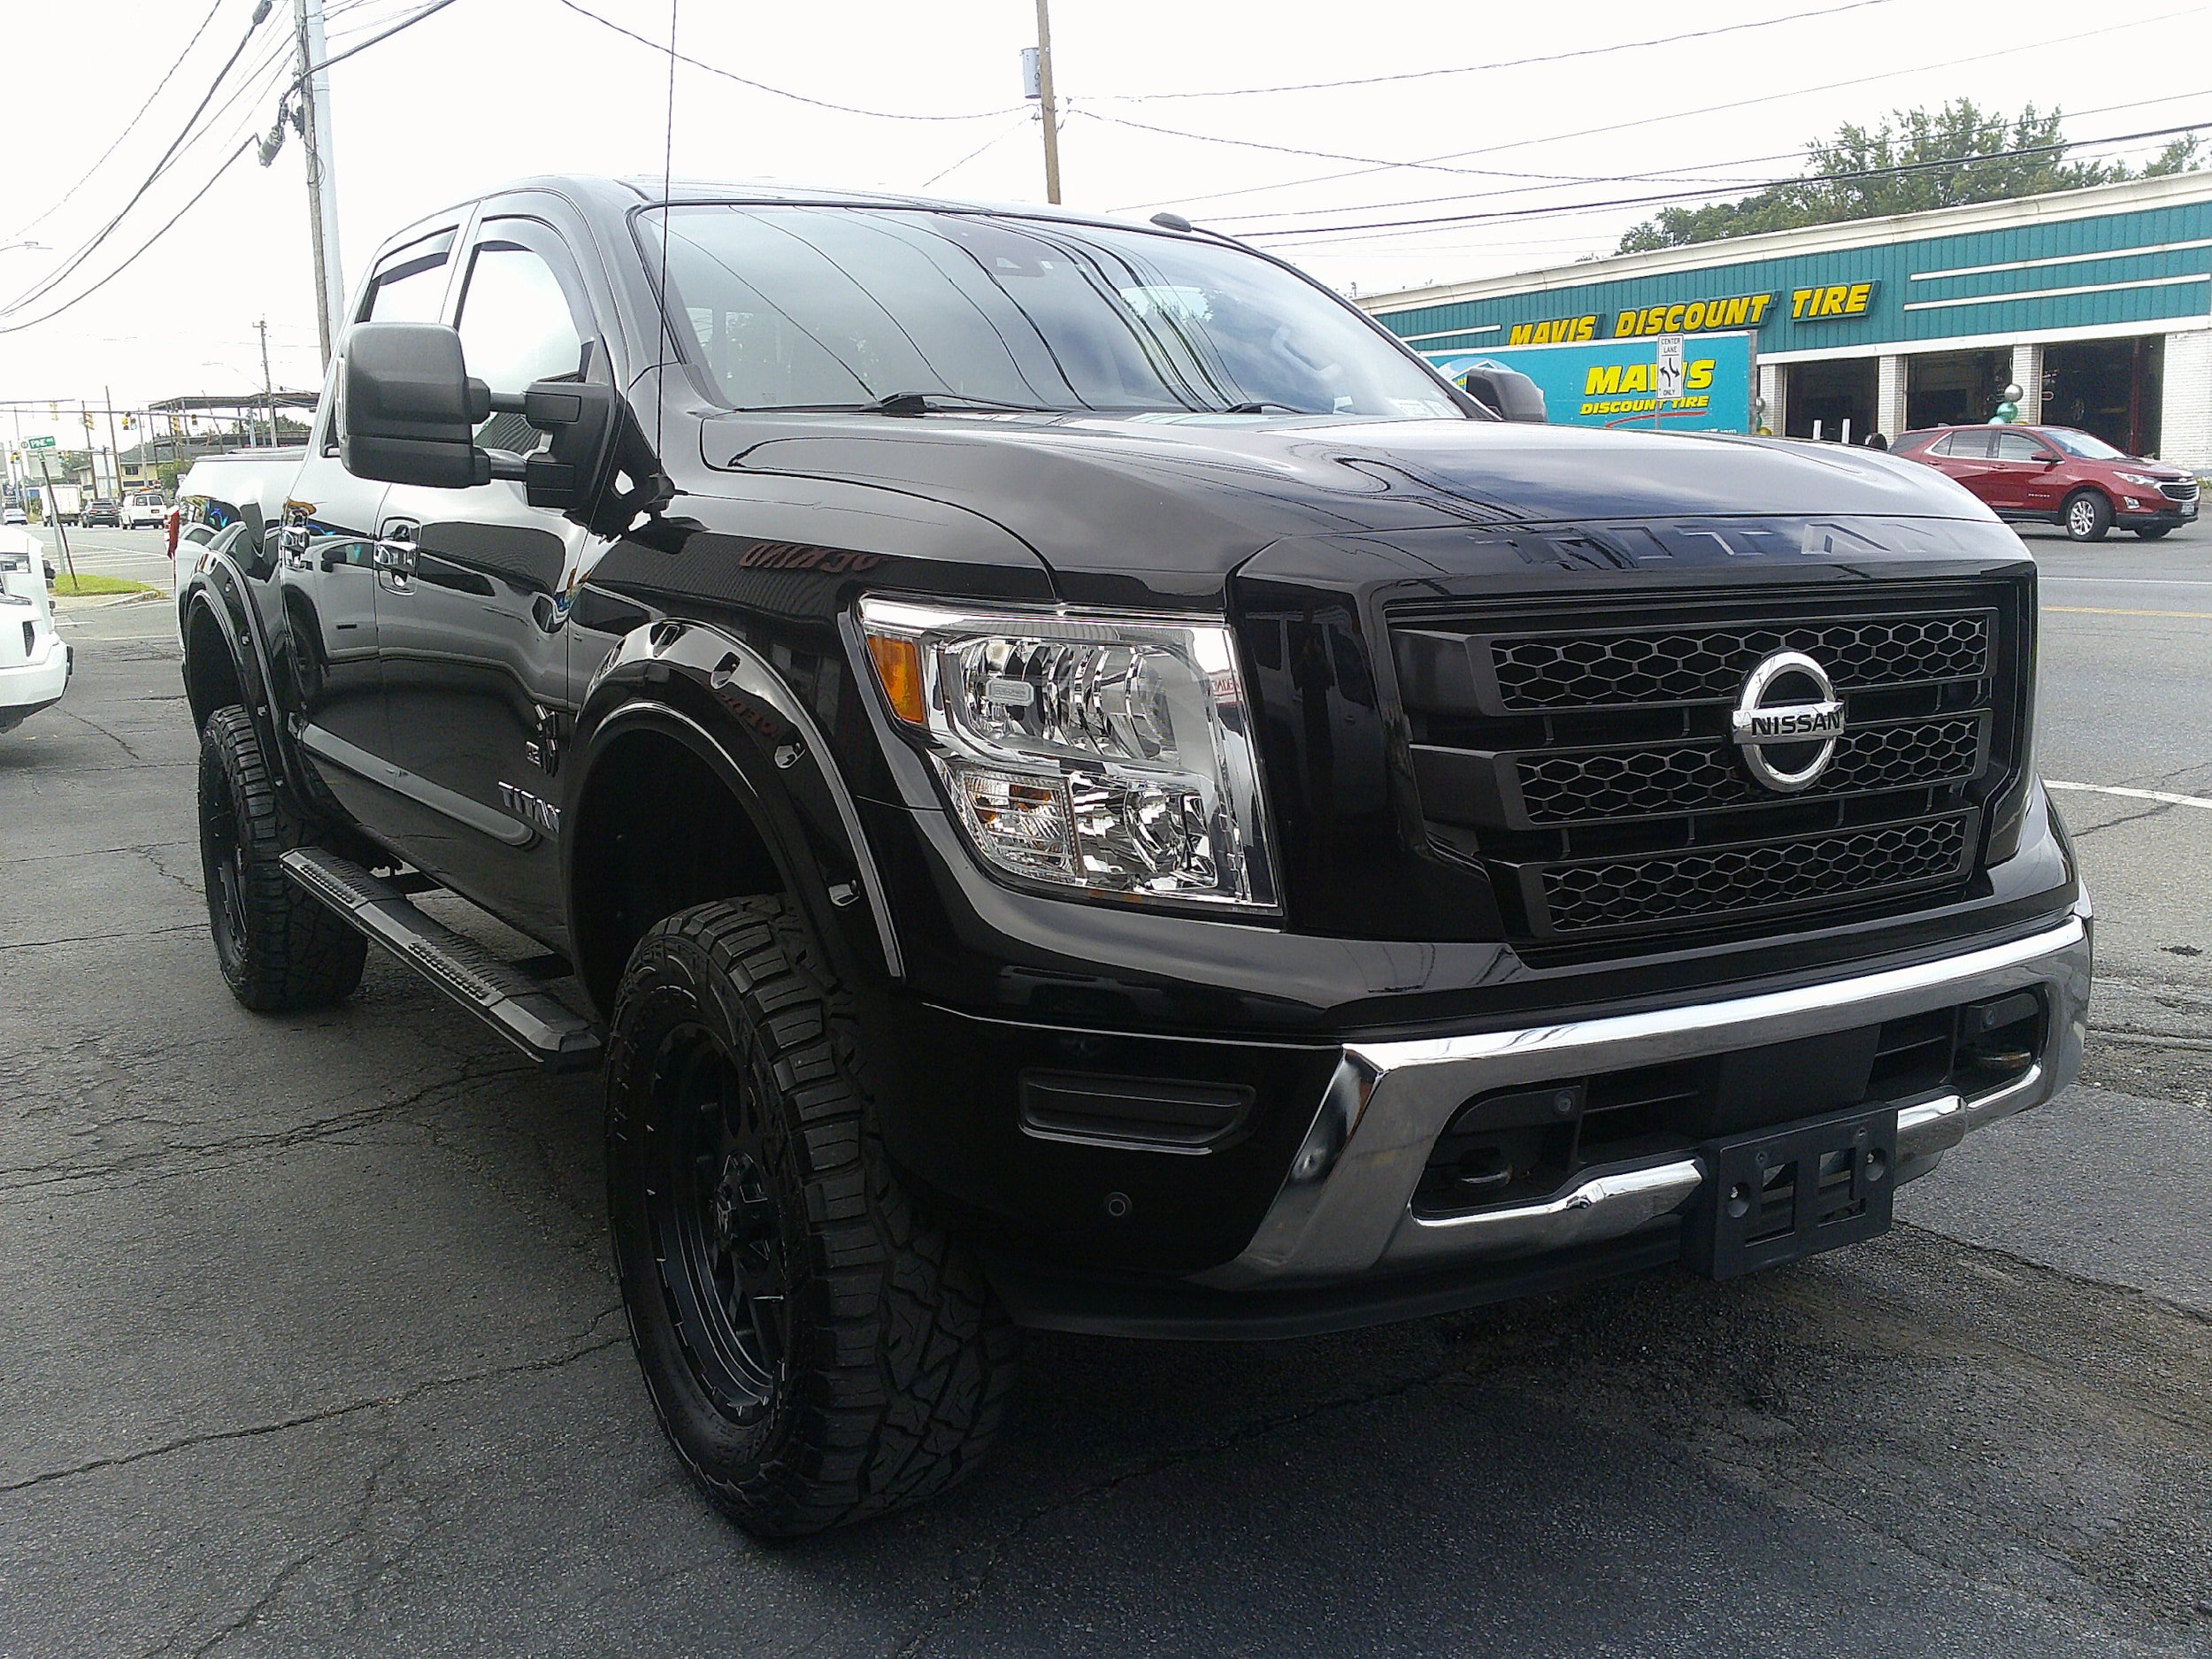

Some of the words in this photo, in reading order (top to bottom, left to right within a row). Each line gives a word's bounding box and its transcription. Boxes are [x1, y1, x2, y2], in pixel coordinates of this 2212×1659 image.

[1509, 315, 1596, 346] MAVIS
[1615, 294, 1772, 338] DISCOUNT
[1791, 283, 1872, 319] TIRE
[1585, 359, 1716, 396] MAS
[1671, 395, 1709, 409] TIRE
[1752, 709, 1841, 735] NISSAN
[498, 780, 561, 833] TITAN
